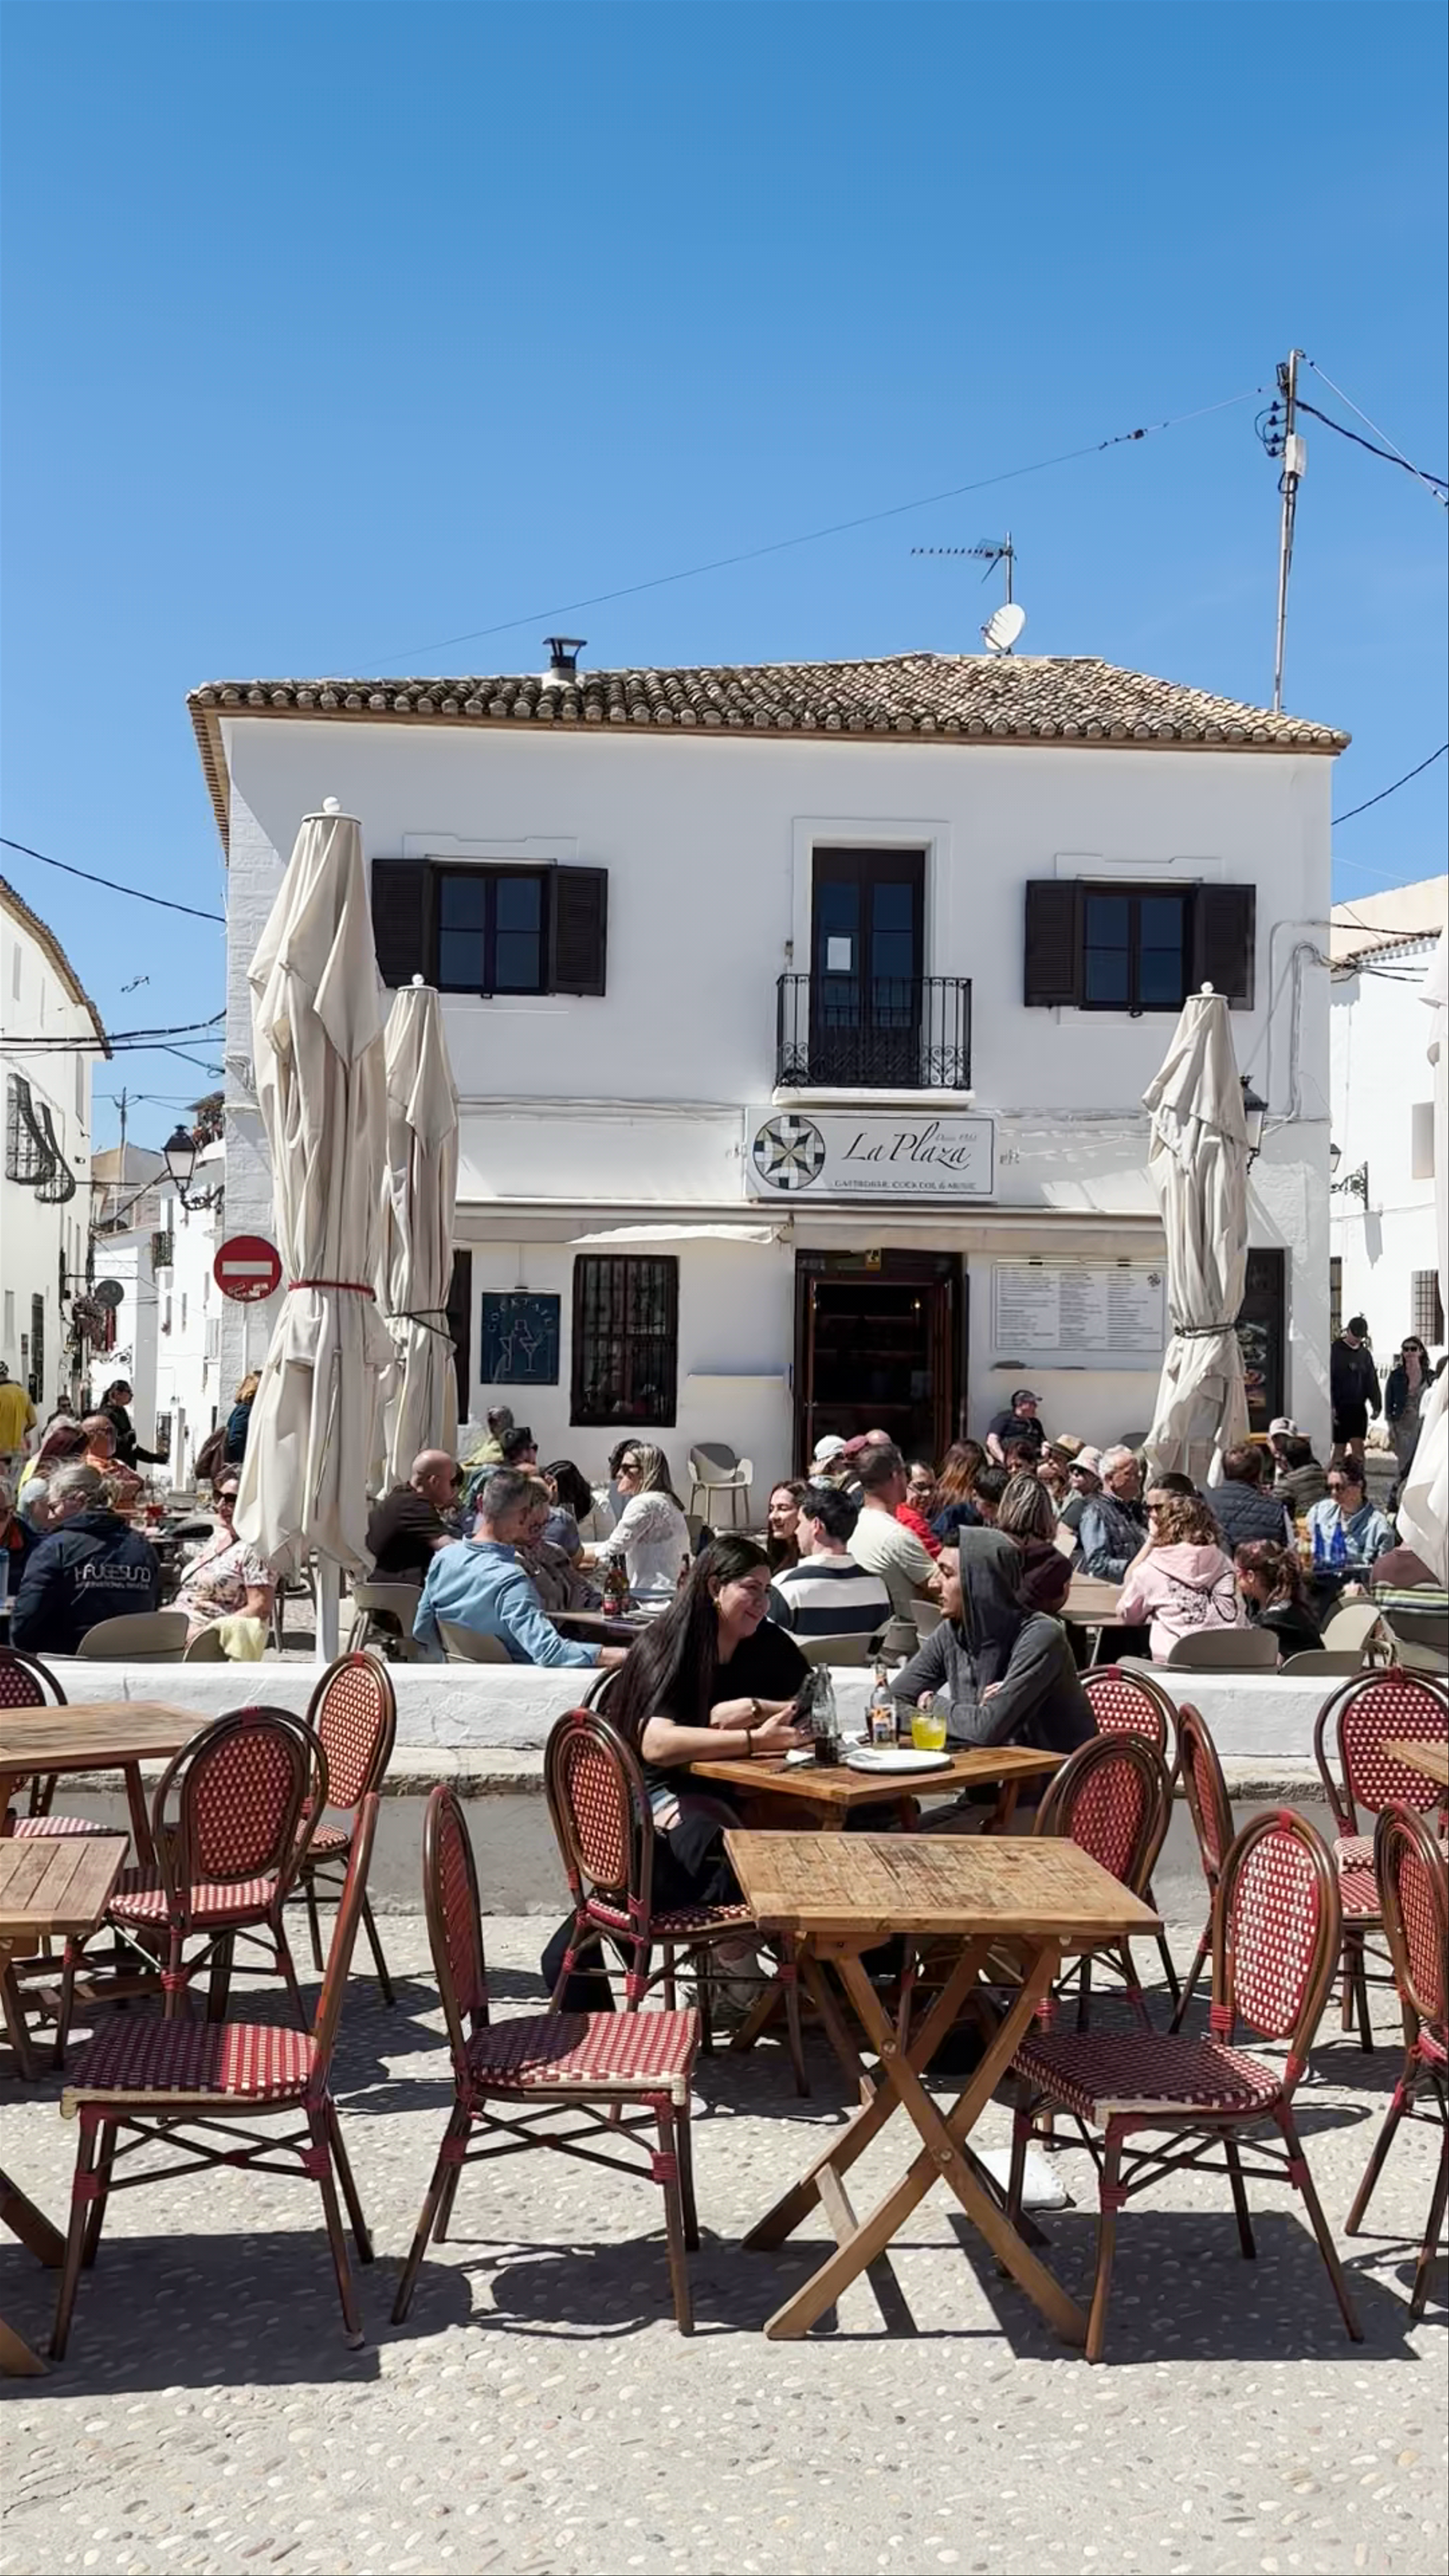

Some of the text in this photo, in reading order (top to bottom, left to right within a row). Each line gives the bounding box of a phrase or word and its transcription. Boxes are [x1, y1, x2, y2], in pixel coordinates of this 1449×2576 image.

[841, 1121, 971, 1170] La Plaza
[74, 1564, 150, 1582] HAUGESUND
